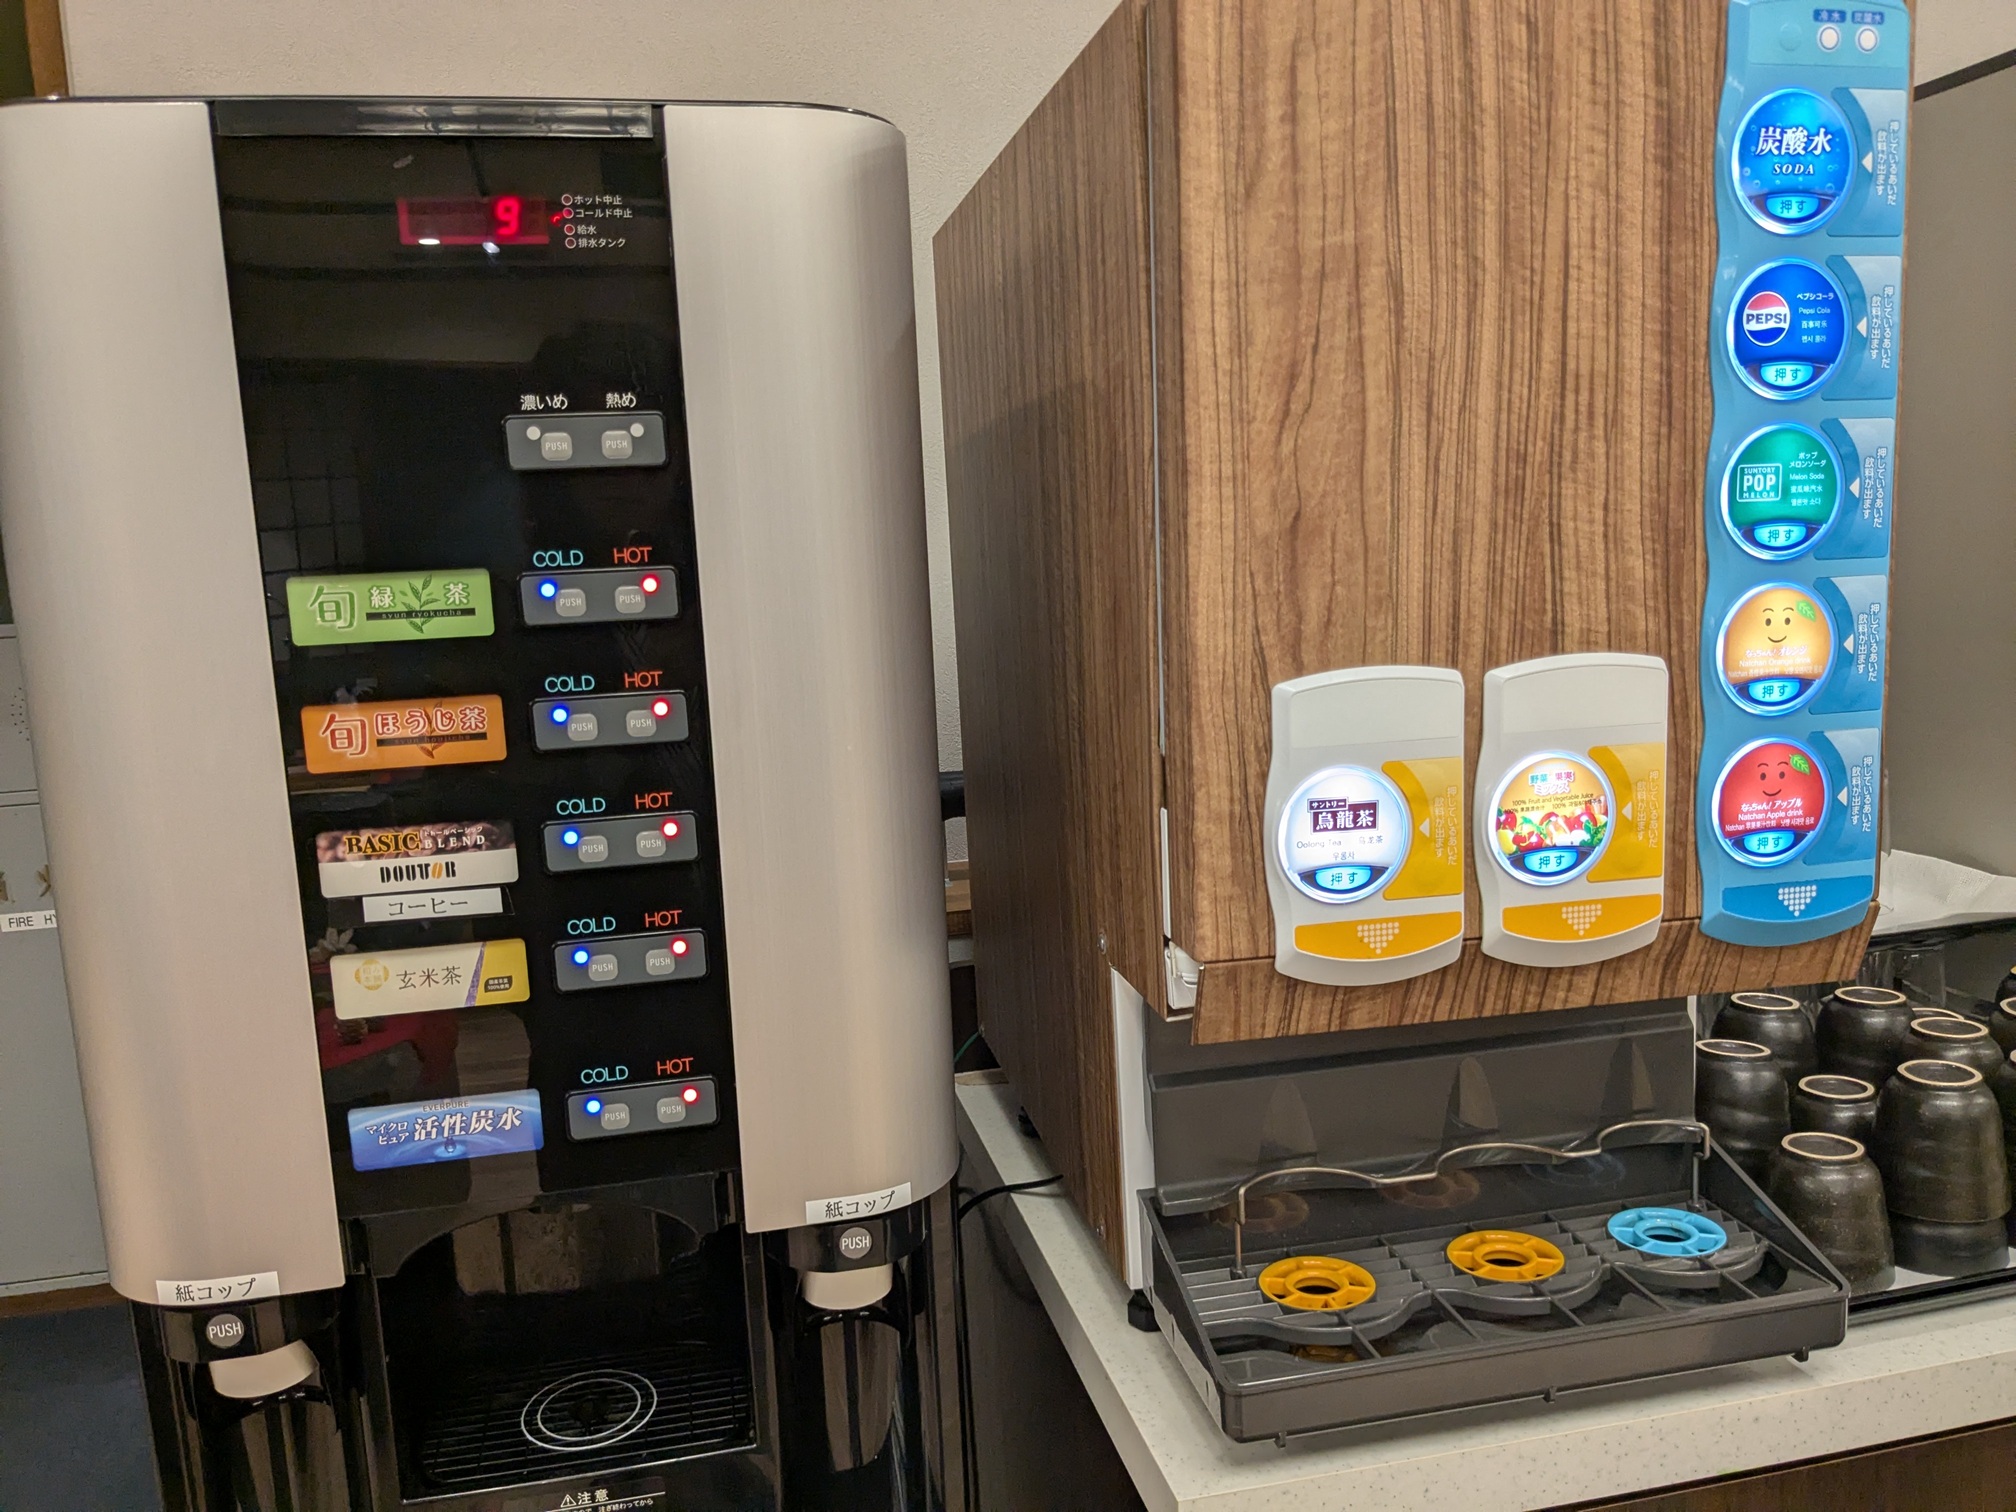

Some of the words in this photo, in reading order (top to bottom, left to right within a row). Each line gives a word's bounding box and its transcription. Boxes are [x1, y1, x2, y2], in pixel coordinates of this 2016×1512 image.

[1755, 126, 1833, 156] 炭酸水
[1772, 163, 1815, 175] SODA
[574, 195, 623, 205] ホット中止
[1780, 199, 1807, 214] 押す
[496, 197, 520, 235] 9
[575, 208, 633, 218] コールド中止
[577, 225, 597, 235] 給水
[578, 238, 626, 248] 排水タンク
[1798, 307, 1815, 315] Pepsi
[1816, 306, 1831, 314] Cola
[1745, 313, 1787, 324] PEPSI
[1870, 295, 1882, 359] 飲料が出ます
[1881, 286, 1895, 368] 押しているあいだ
[1774, 368, 1801, 382] 押す
[521, 393, 568, 410] 濃いめ
[606, 392, 636, 409] 熱め
[545, 442, 568, 451] PUSH
[606, 440, 628, 449] PUSH
[1798, 451, 1818, 459] ポップ
[1788, 460, 1826, 468] メロンソーダ
[1743, 474, 1777, 491] POP
[1809, 472, 1825, 480] Soda
[1743, 491, 1775, 499] MELON
[1862, 457, 1875, 519] 飲料が出ます
[1873, 448, 1887, 528] 押しているあいだ
[1768, 528, 1794, 543] 押す
[533, 550, 583, 568] COLD
[614, 547, 652, 564] HOT
[560, 597, 582, 608] PUSH
[619, 594, 641, 604] PUSH
[309, 585, 357, 631] 旬
[382, 611, 407, 619] syun
[412, 609, 462, 618] ryokucha
[1857, 613, 1868, 674] 飲料が出ます
[1867, 604, 1880, 682] 押しているあいだ
[545, 676, 595, 693] COLD
[625, 671, 662, 688] HOT
[1762, 684, 1788, 698] 押す
[571, 721, 594, 733] PUSH
[630, 718, 652, 729] PUSH
[321, 713, 368, 757] 旬
[375, 706, 487, 736] ほうじ茶
[1535, 783, 1570, 795] ミックス
[1851, 766, 1862, 825] 飲料が出ます
[1861, 756, 1873, 832] 押しているあいだ
[556, 797, 606, 815] COLD
[635, 792, 673, 809] HOT
[1311, 800, 1345, 809] サントリー
[1553, 794, 1580, 803] Vegetable
[1773, 797, 1803, 809] アップル
[1636, 780, 1647, 841] 飲料が出ます
[1648, 770, 1660, 848] 押しているあいだ
[1738, 812, 1766, 821] Natchan
[1766, 811, 1786, 820] Apple
[1786, 809, 1804, 817] drink
[1316, 809, 1374, 830] 烏龍茶
[1446, 786, 1458, 865] 押しているあいだ
[345, 831, 421, 855] BASIC
[424, 835, 486, 849] BLEND
[582, 844, 604, 854] PUSH
[640, 839, 662, 849] PUSH
[1296, 840, 1325, 849] Oolong
[1756, 835, 1783, 850] 押す
[1538, 854, 1565, 869] 押す
[380, 861, 457, 883] DOUTOR
[1331, 872, 1358, 886] 押す
[388, 898, 469, 916] コーヒー
[8, 915, 34, 928] FIRE
[567, 917, 616, 935] COLD
[645, 910, 682, 927] HOT
[592, 962, 614, 973] PUSH
[650, 956, 671, 967] PUSH
[396, 965, 463, 990] 玄米茶
[657, 1057, 693, 1075] HOT
[581, 1065, 628, 1084] COLD
[422, 1100, 470, 1112] EVERPURE
[661, 1104, 682, 1115] PUSH
[413, 1106, 523, 1141] 活性炭水
[604, 1111, 626, 1121] PUSH
[366, 1121, 408, 1135] マイクロ
[378, 1132, 410, 1145] ピュア
[825, 1190, 896, 1219] 紙コップ
[841, 1235, 870, 1250] PUSH
[175, 1277, 256, 1302] 紙コップ
[208, 1321, 242, 1339] PUSH
[577, 1488, 609, 1505] 注意
